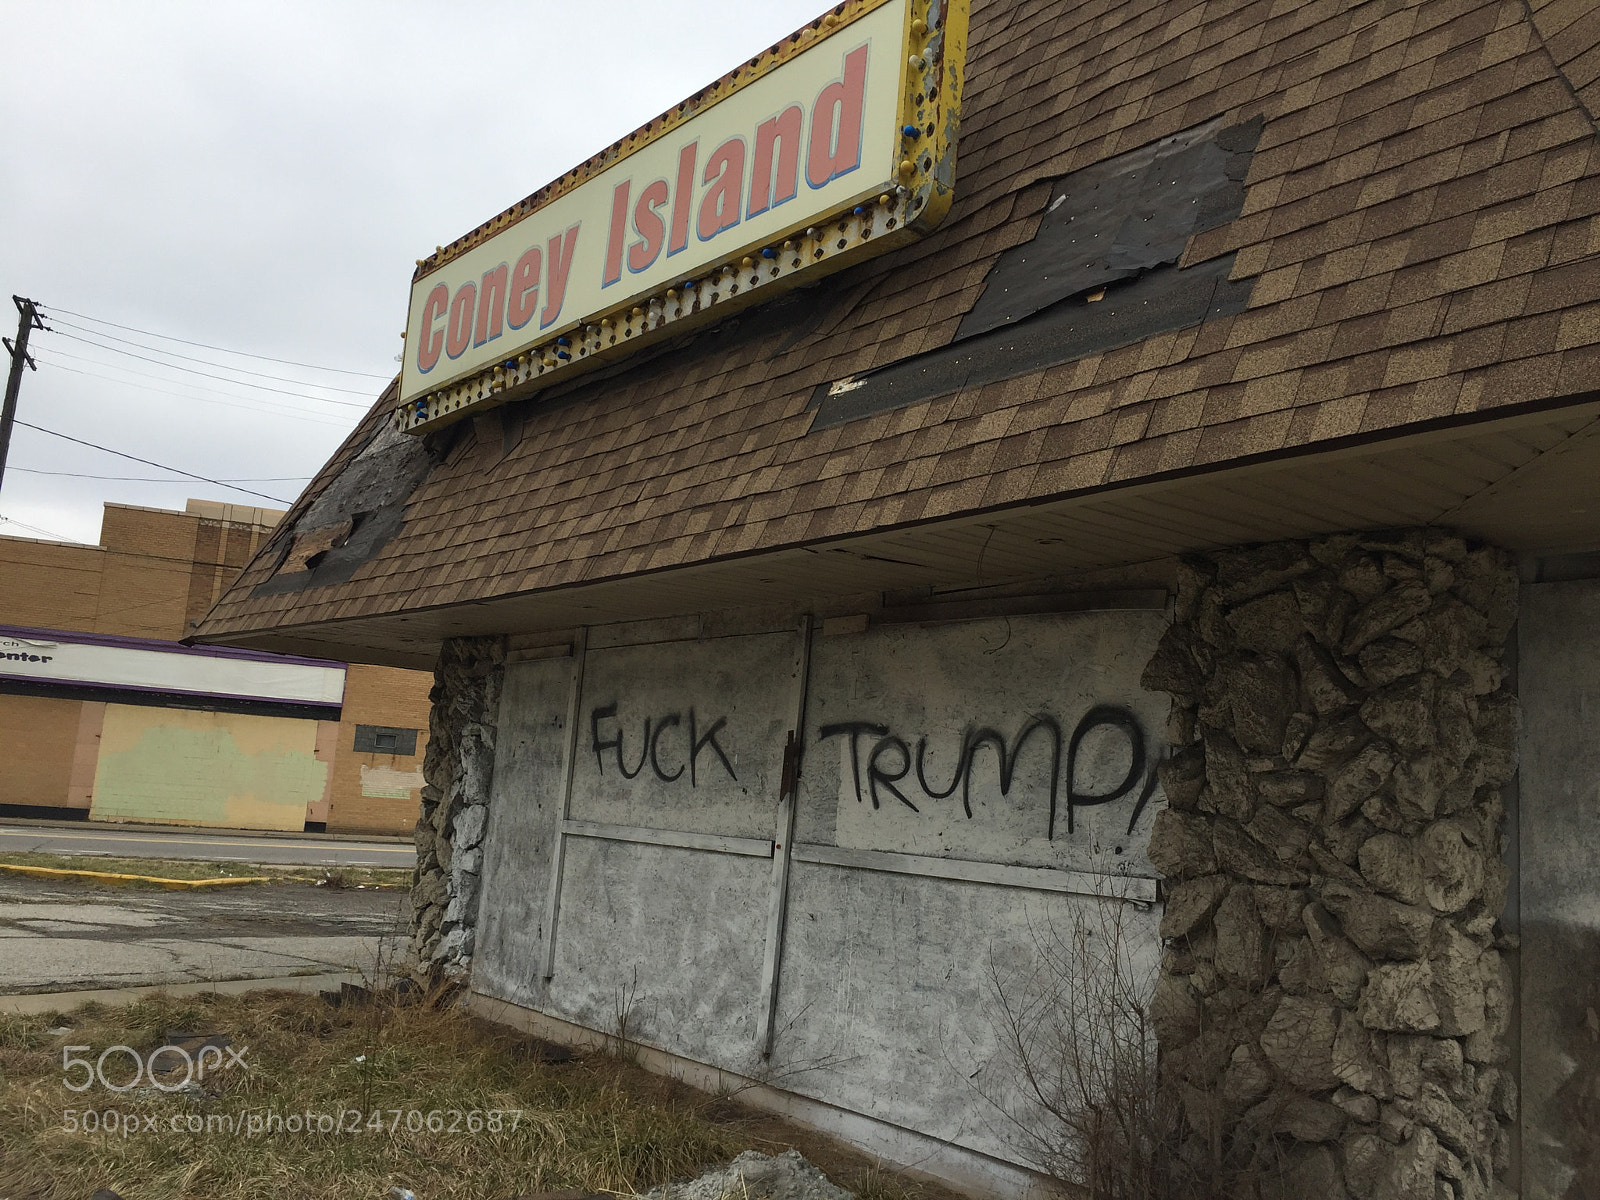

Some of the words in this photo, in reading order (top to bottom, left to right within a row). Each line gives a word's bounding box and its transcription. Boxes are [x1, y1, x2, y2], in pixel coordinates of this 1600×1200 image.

[416, 220, 582, 375] Coney
[601, 37, 872, 290] Island
[590, 701, 738, 788] FUCK
